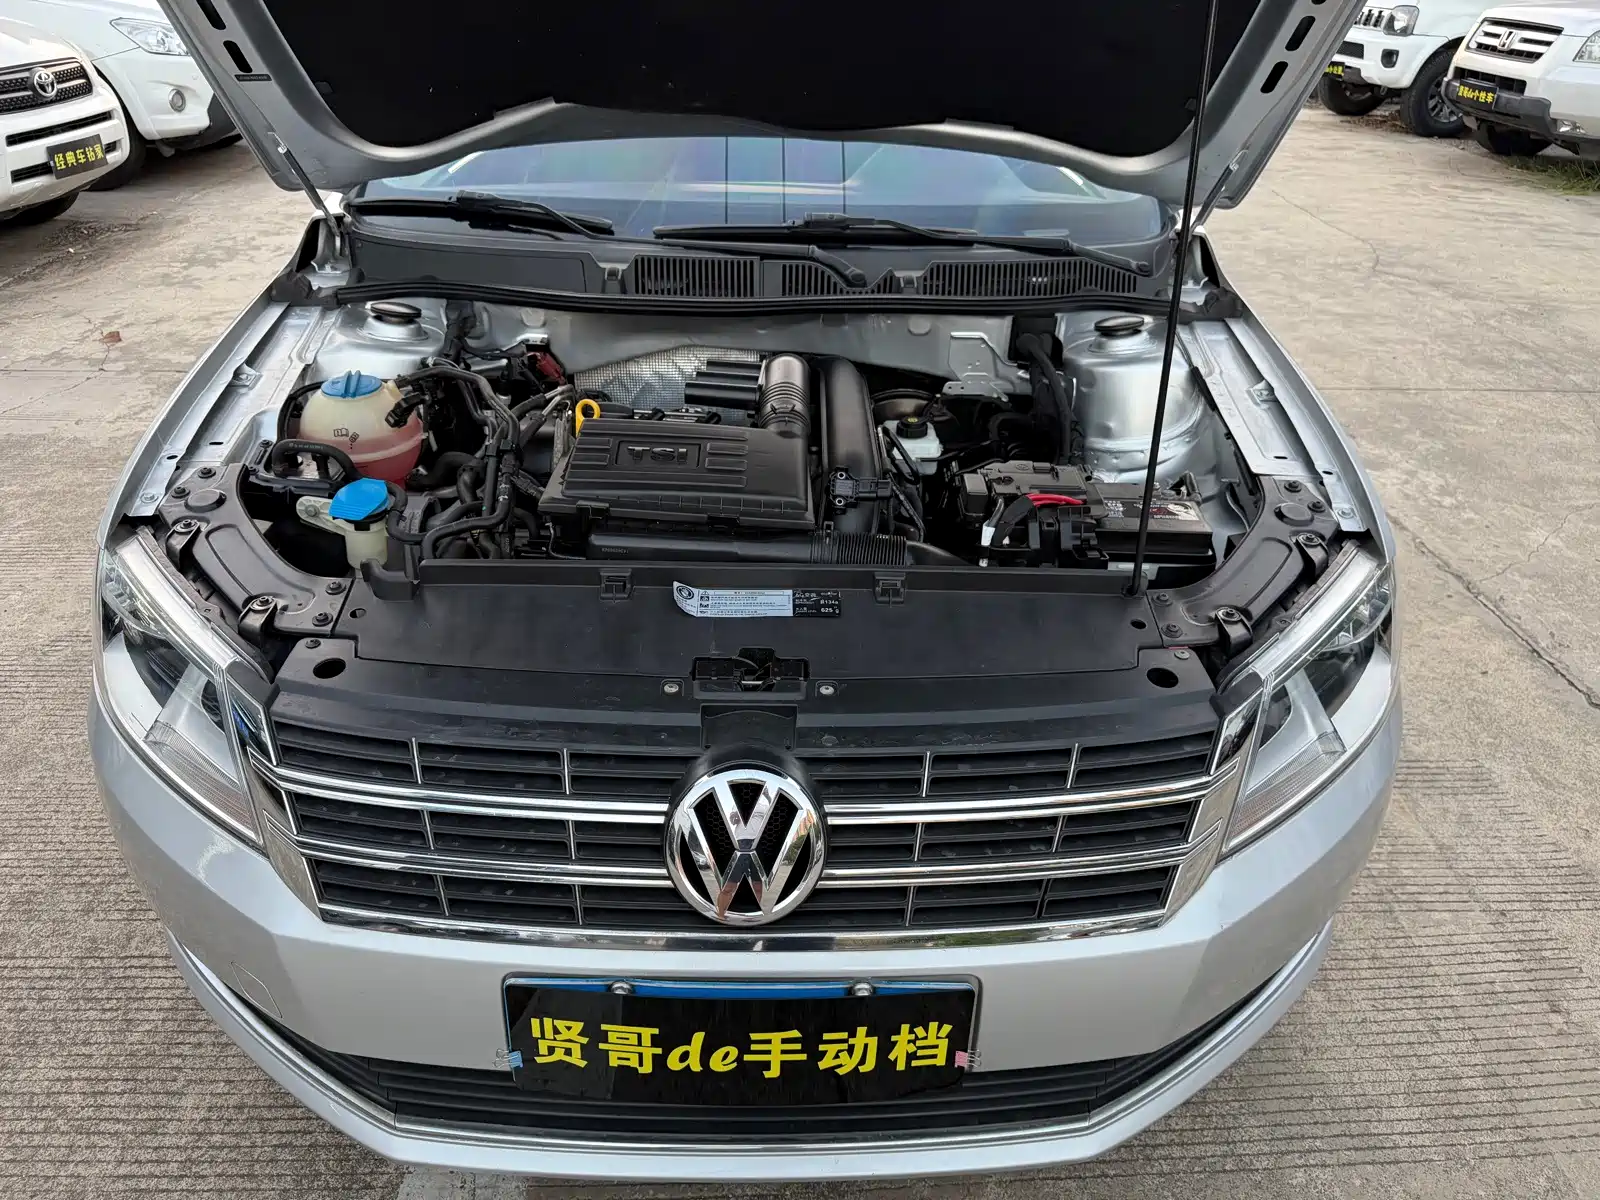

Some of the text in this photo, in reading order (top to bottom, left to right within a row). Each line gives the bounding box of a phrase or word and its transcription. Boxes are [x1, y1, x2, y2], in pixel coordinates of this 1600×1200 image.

[627, 446, 688, 463] TSI
[530, 1016, 955, 1078] 贤哥de手动档
